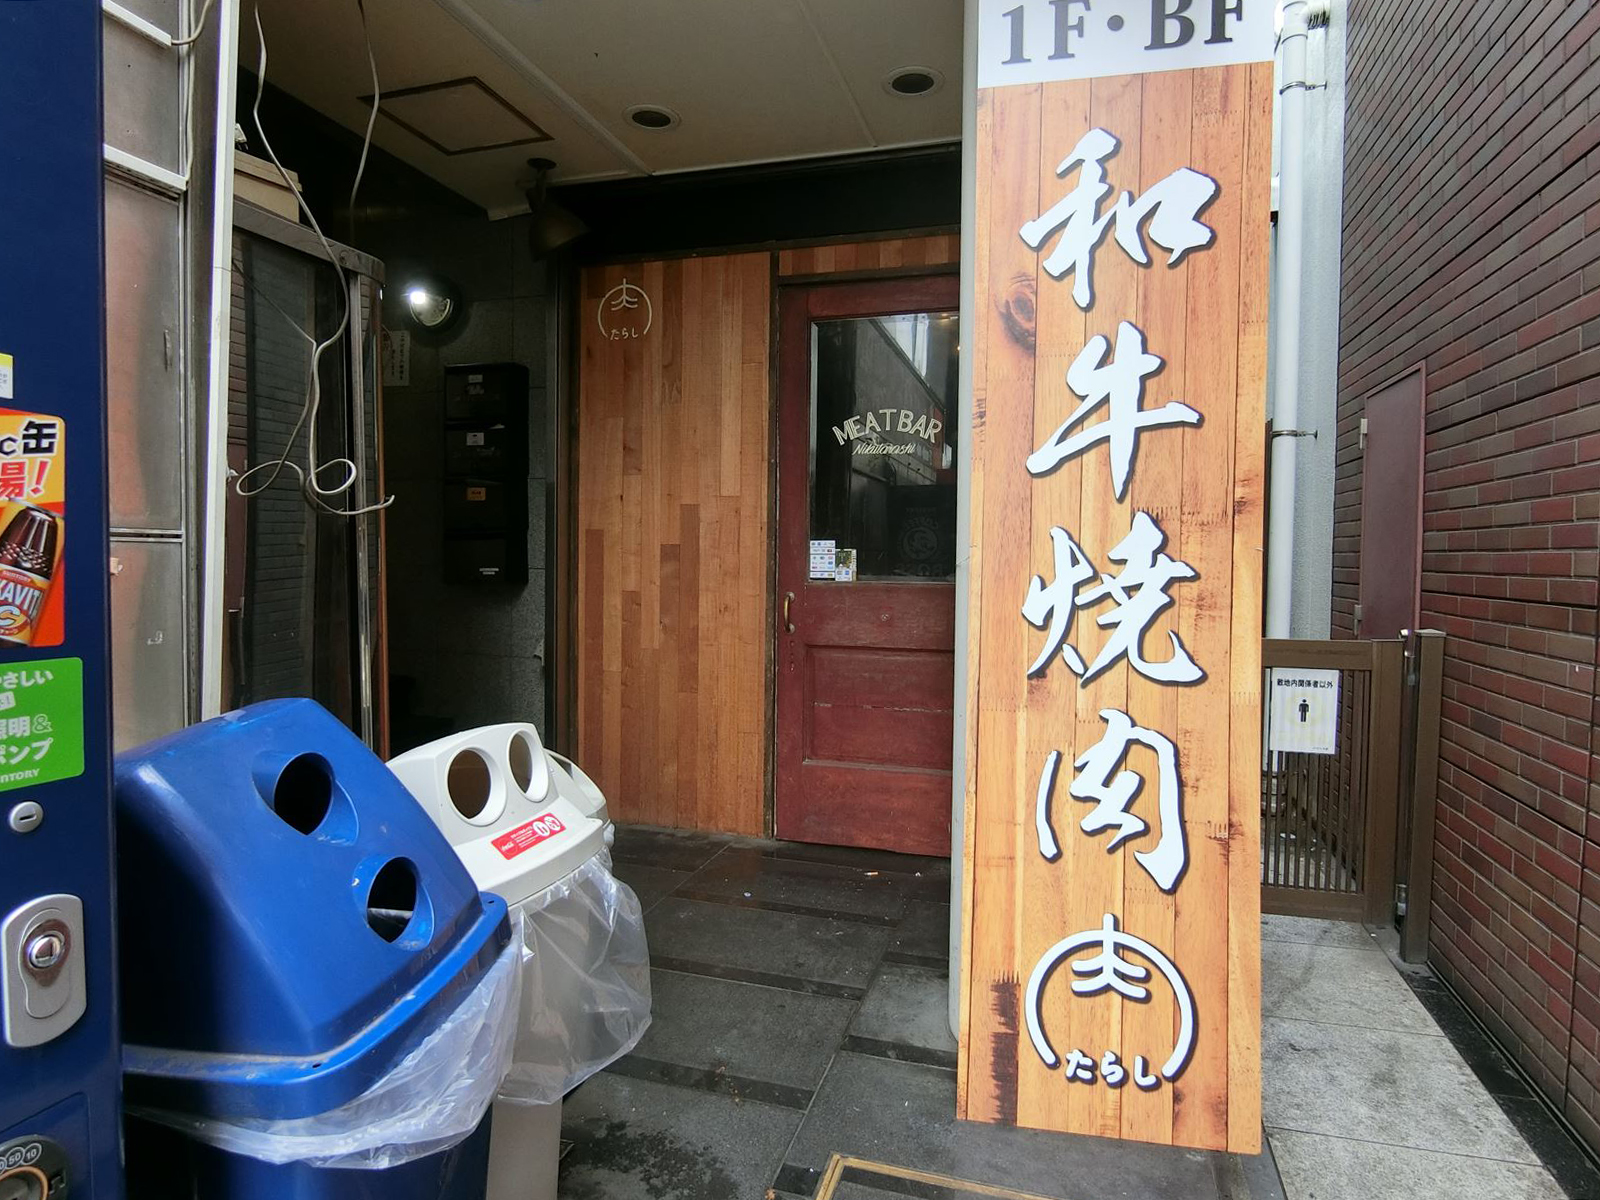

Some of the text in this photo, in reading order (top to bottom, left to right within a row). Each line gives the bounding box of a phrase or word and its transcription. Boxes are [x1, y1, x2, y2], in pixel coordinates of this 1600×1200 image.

[610, 327, 639, 341] たらし
[1019, 127, 1218, 893] 和牛焼肉
[0, 670, 54, 690] さしい
[0, 736, 54, 765] ンプ
[1064, 1048, 1160, 1089] たらし
[9, 1153, 21, 1164] 50
[26, 1149, 37, 1159] 10
